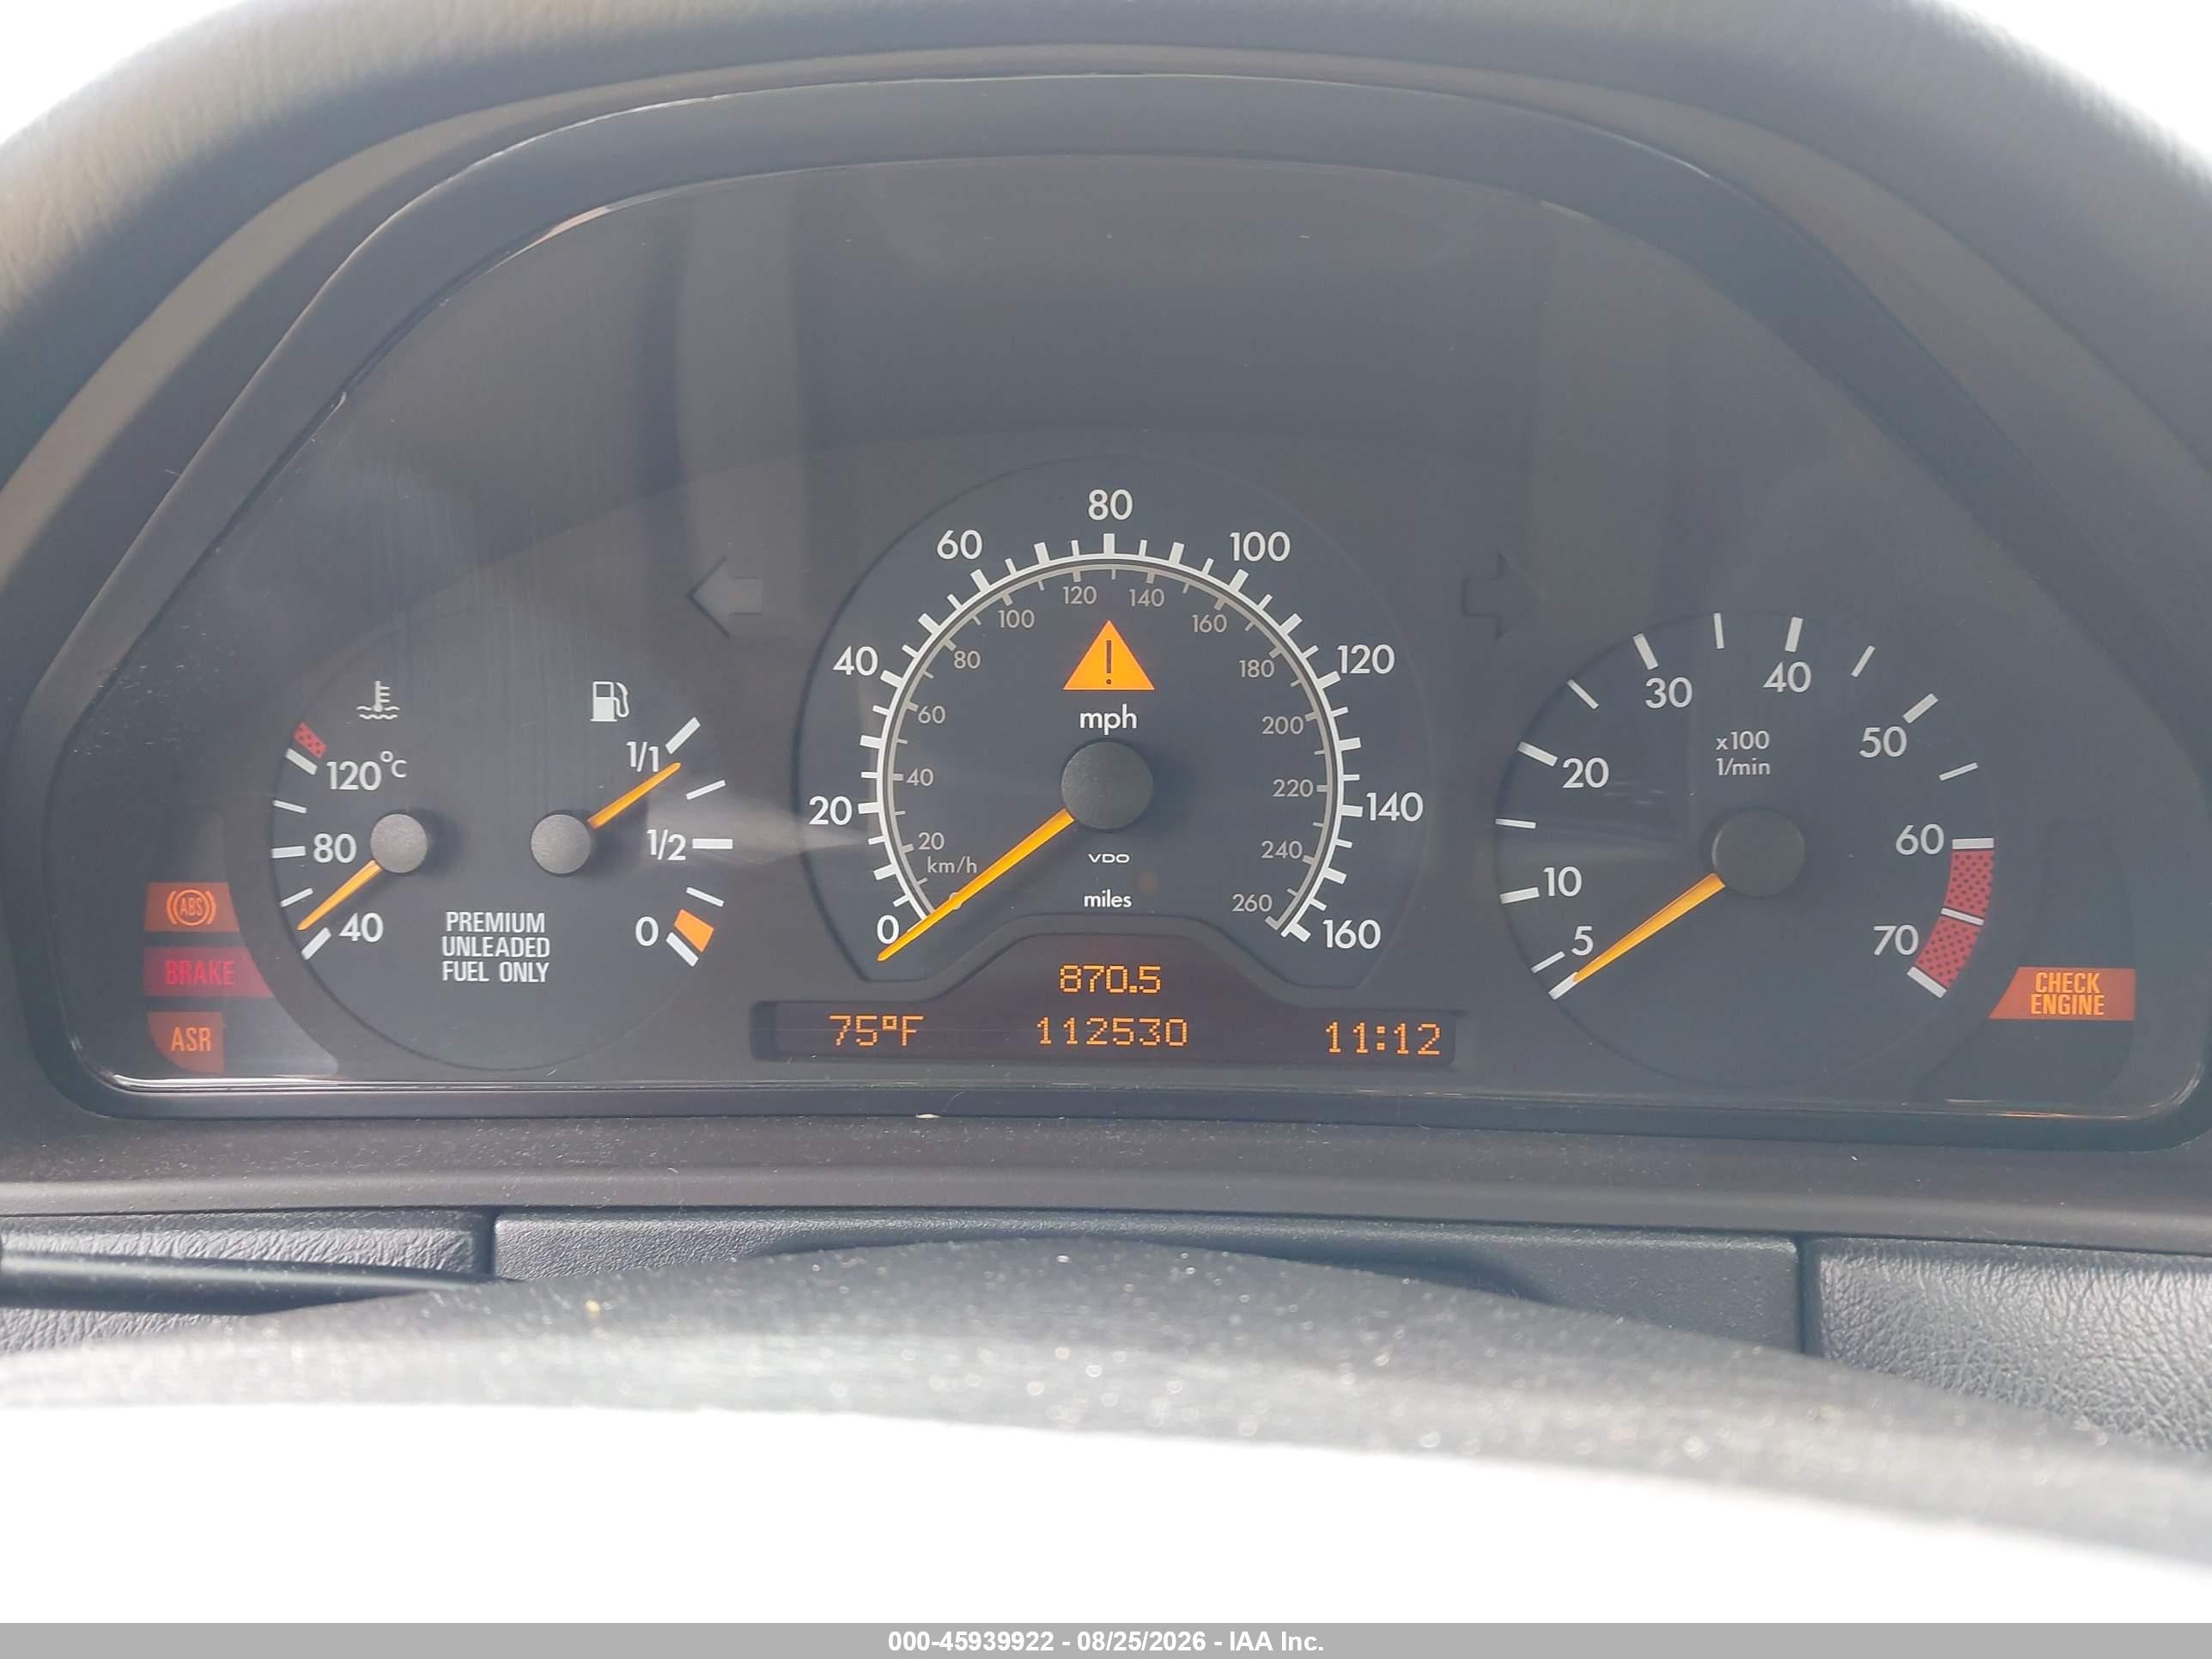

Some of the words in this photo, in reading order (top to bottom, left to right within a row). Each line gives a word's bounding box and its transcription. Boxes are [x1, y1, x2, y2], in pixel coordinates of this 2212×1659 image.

[1087, 489, 1133, 521] 80
[936, 530, 982, 562] 60
[1230, 532, 1290, 562] 100
[1062, 585, 1097, 606] 120
[1129, 587, 1165, 609] 140
[998, 609, 1035, 629] 100
[1192, 614, 1228, 635] 160
[833, 646, 878, 677] 40
[953, 649, 981, 671] 80
[1239, 659, 1275, 679] 180
[1339, 644, 1395, 675] 120
[1763, 661, 1811, 693] 40
[1645, 678, 1692, 709] 30
[918, 704, 945, 726] 60
[1079, 704, 1138, 737] mph
[1261, 715, 1304, 736] 200
[1716, 730, 1771, 751] x100
[1859, 726, 1907, 759] 50
[627, 742, 659, 772] 1/1
[1717, 757, 1771, 778] 1/min
[906, 767, 934, 788] 40
[1562, 757, 1609, 789] 20
[1273, 778, 1314, 799] 220
[809, 796, 853, 826] 20
[1366, 792, 1424, 822] 140
[313, 834, 356, 863] 80
[647, 830, 686, 860] 1/2
[918, 831, 945, 852] 20
[1261, 840, 1304, 861] 240
[1895, 823, 1944, 855] 60
[927, 856, 978, 876] km/h
[1088, 853, 1129, 864] VDO
[1543, 866, 1583, 897] 10
[179, 897, 202, 916] ABS
[1084, 890, 1132, 908] miles
[1232, 893, 1273, 914] 260
[339, 914, 383, 942] 40
[446, 912, 545, 933] PREMIUM
[635, 918, 658, 945] 0
[877, 915, 899, 945] 0
[1325, 919, 1381, 950] 160
[442, 936, 550, 958] UNLEADED
[1571, 926, 1595, 956] 5
[1873, 925, 1918, 956] 70
[165, 959, 234, 985] BRAKE
[442, 961, 489, 982] FUEL
[499, 962, 550, 983] ONLY
[1060, 964, 1163, 994] 870.5
[2035, 972, 2100, 995] CHECK
[2030, 994, 2105, 1017] ENGINE
[172, 1026, 211, 1052] ASR
[1036, 1017, 1189, 1046] 112530
[1326, 1023, 1442, 1055] 11:12
